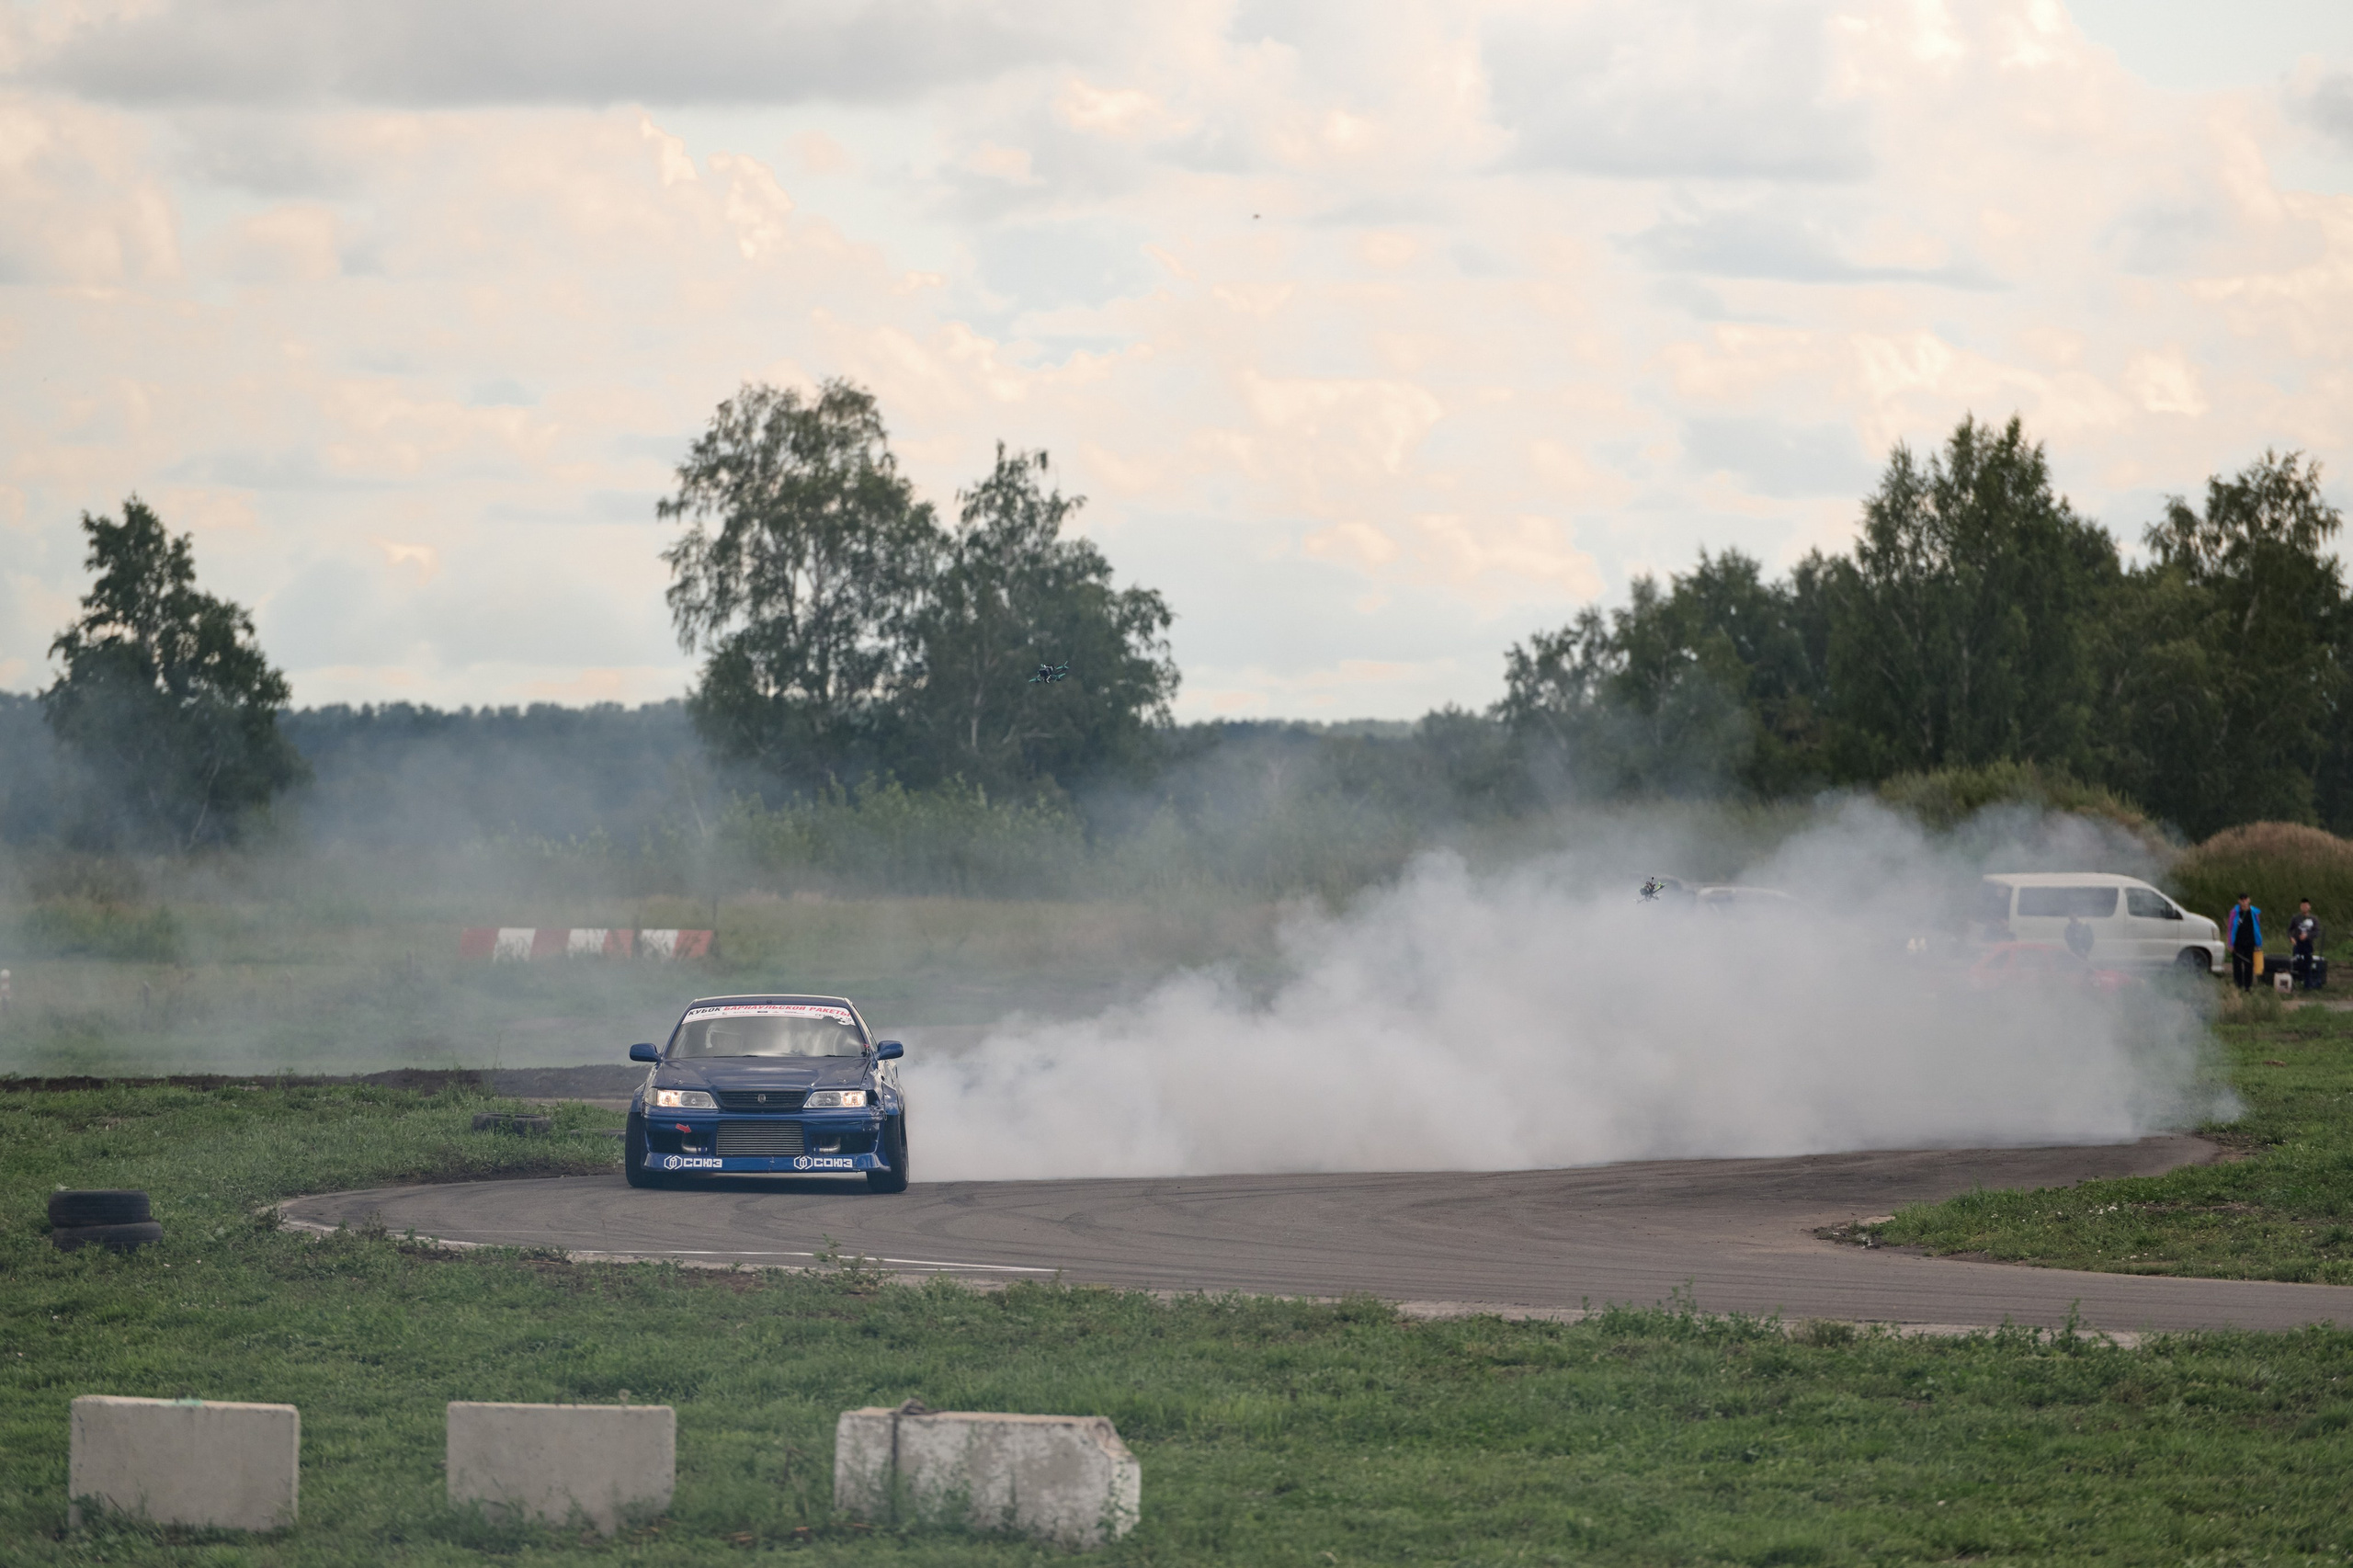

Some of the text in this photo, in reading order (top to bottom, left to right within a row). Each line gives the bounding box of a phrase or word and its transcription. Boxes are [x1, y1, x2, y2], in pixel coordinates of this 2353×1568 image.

[688, 1006, 722, 1016] КУБОК
[809, 1006, 851, 1017] РАКЕТЫ
[683, 1158, 723, 1168] СОЮЗ
[813, 1158, 853, 1168] СОЮЗ
